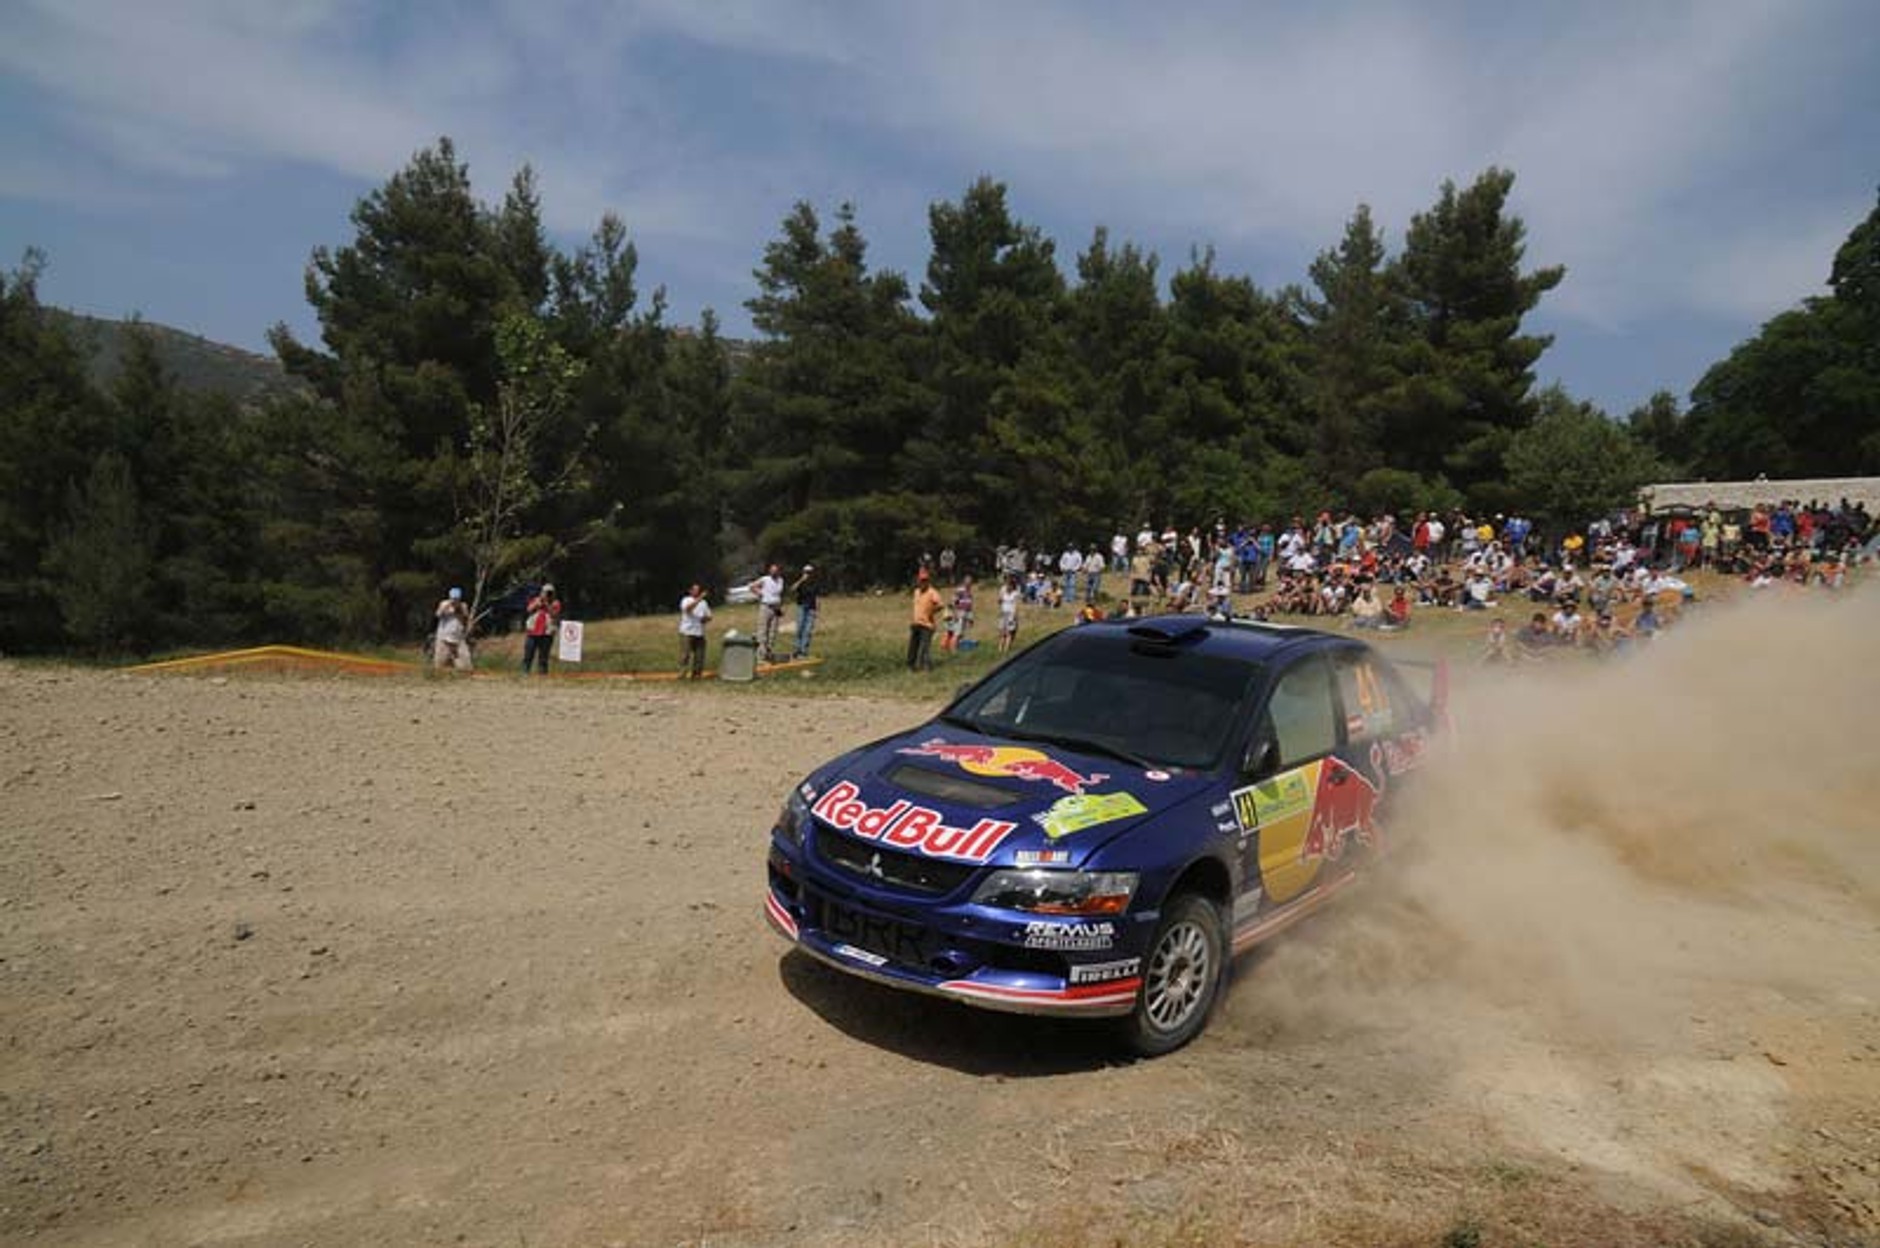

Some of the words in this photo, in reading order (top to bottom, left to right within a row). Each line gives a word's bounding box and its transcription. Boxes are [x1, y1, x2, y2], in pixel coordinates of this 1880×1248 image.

[812, 781, 911, 838] Red
[882, 806, 1017, 864] Bull
[1025, 921, 1114, 937] REMUS
[1069, 957, 1140, 983] PIRELLI
